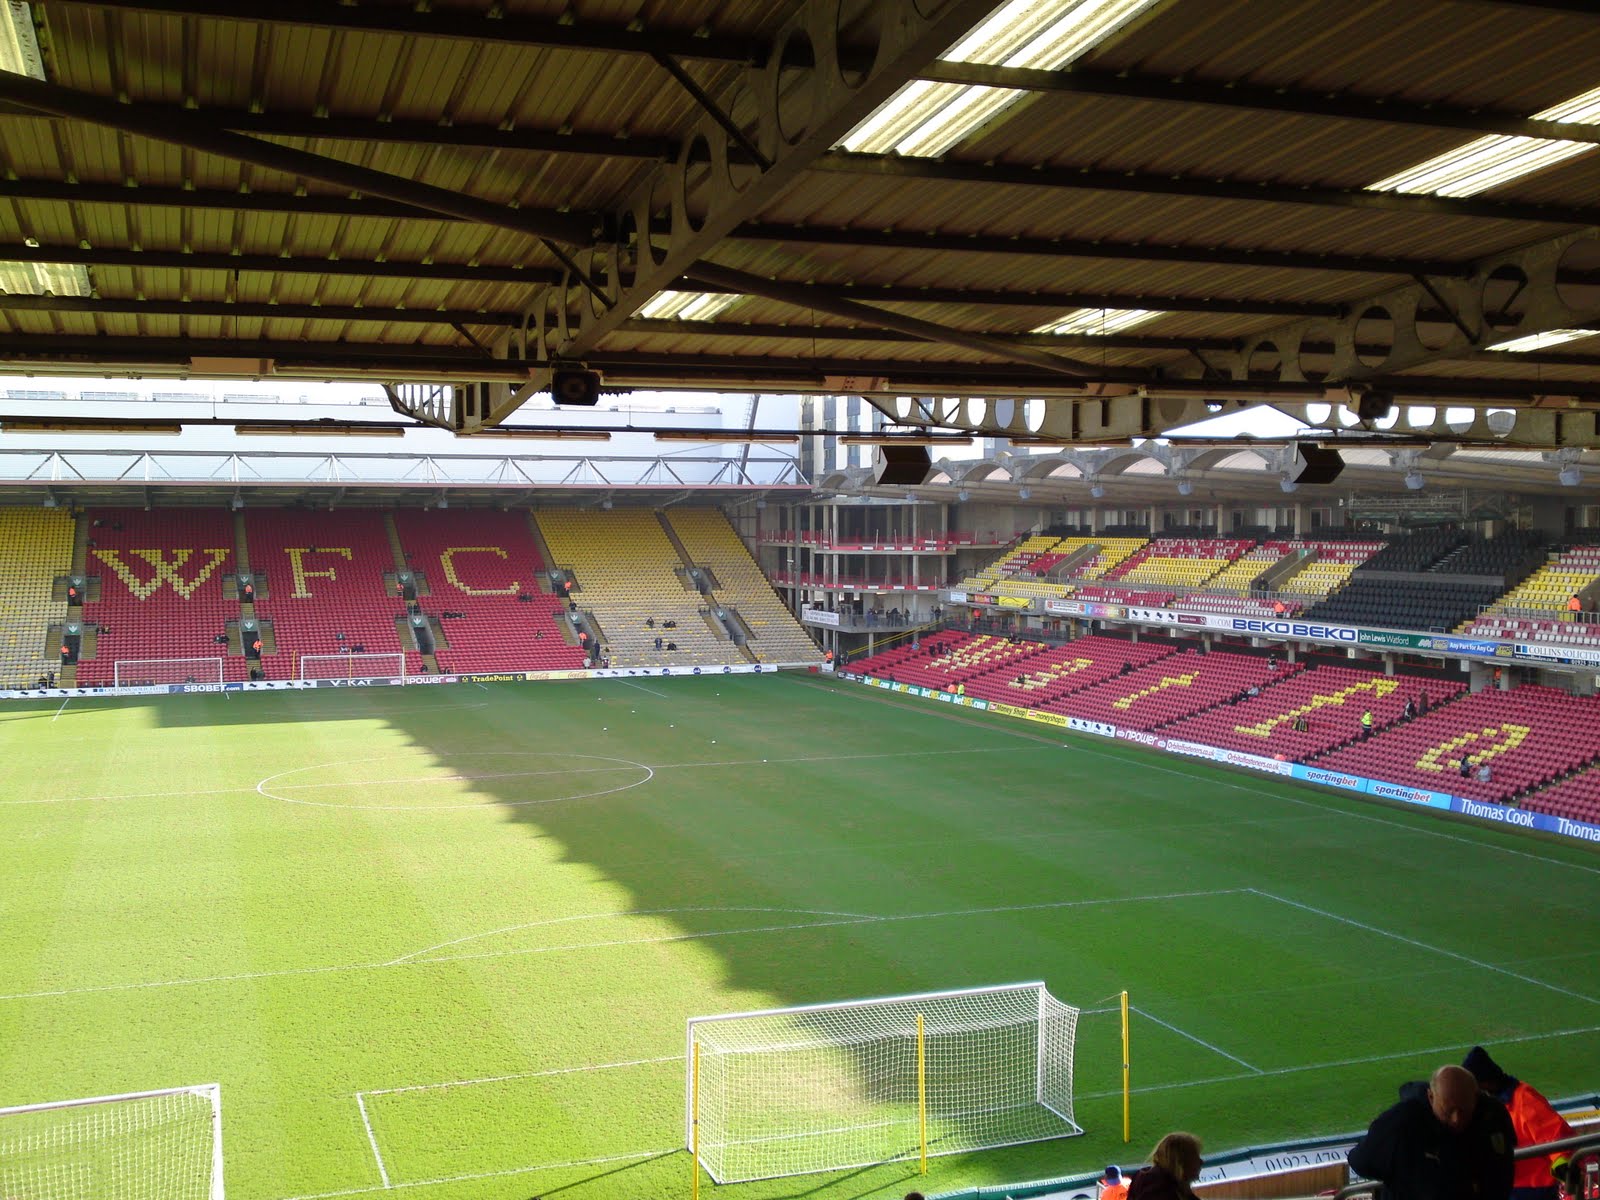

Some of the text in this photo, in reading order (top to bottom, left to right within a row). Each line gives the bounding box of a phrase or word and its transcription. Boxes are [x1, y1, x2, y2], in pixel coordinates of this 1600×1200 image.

[1232, 618, 1290, 634] BEKO
[1292, 624, 1356, 641] BEKO
[1360, 632, 1409, 645] John Lewis Watford
[1450, 642, 1458, 650] Any
[1528, 646, 1600, 660] COLLINS SOLICITO
[471, 675, 513, 683] TradePoint
[1013, 708, 1026, 717] Shop
[1124, 730, 1158, 746] npower
[1306, 769, 1358, 787] sportingbet
[1374, 784, 1431, 803] sportingbet
[1461, 799, 1535, 828] Thomas Cook
